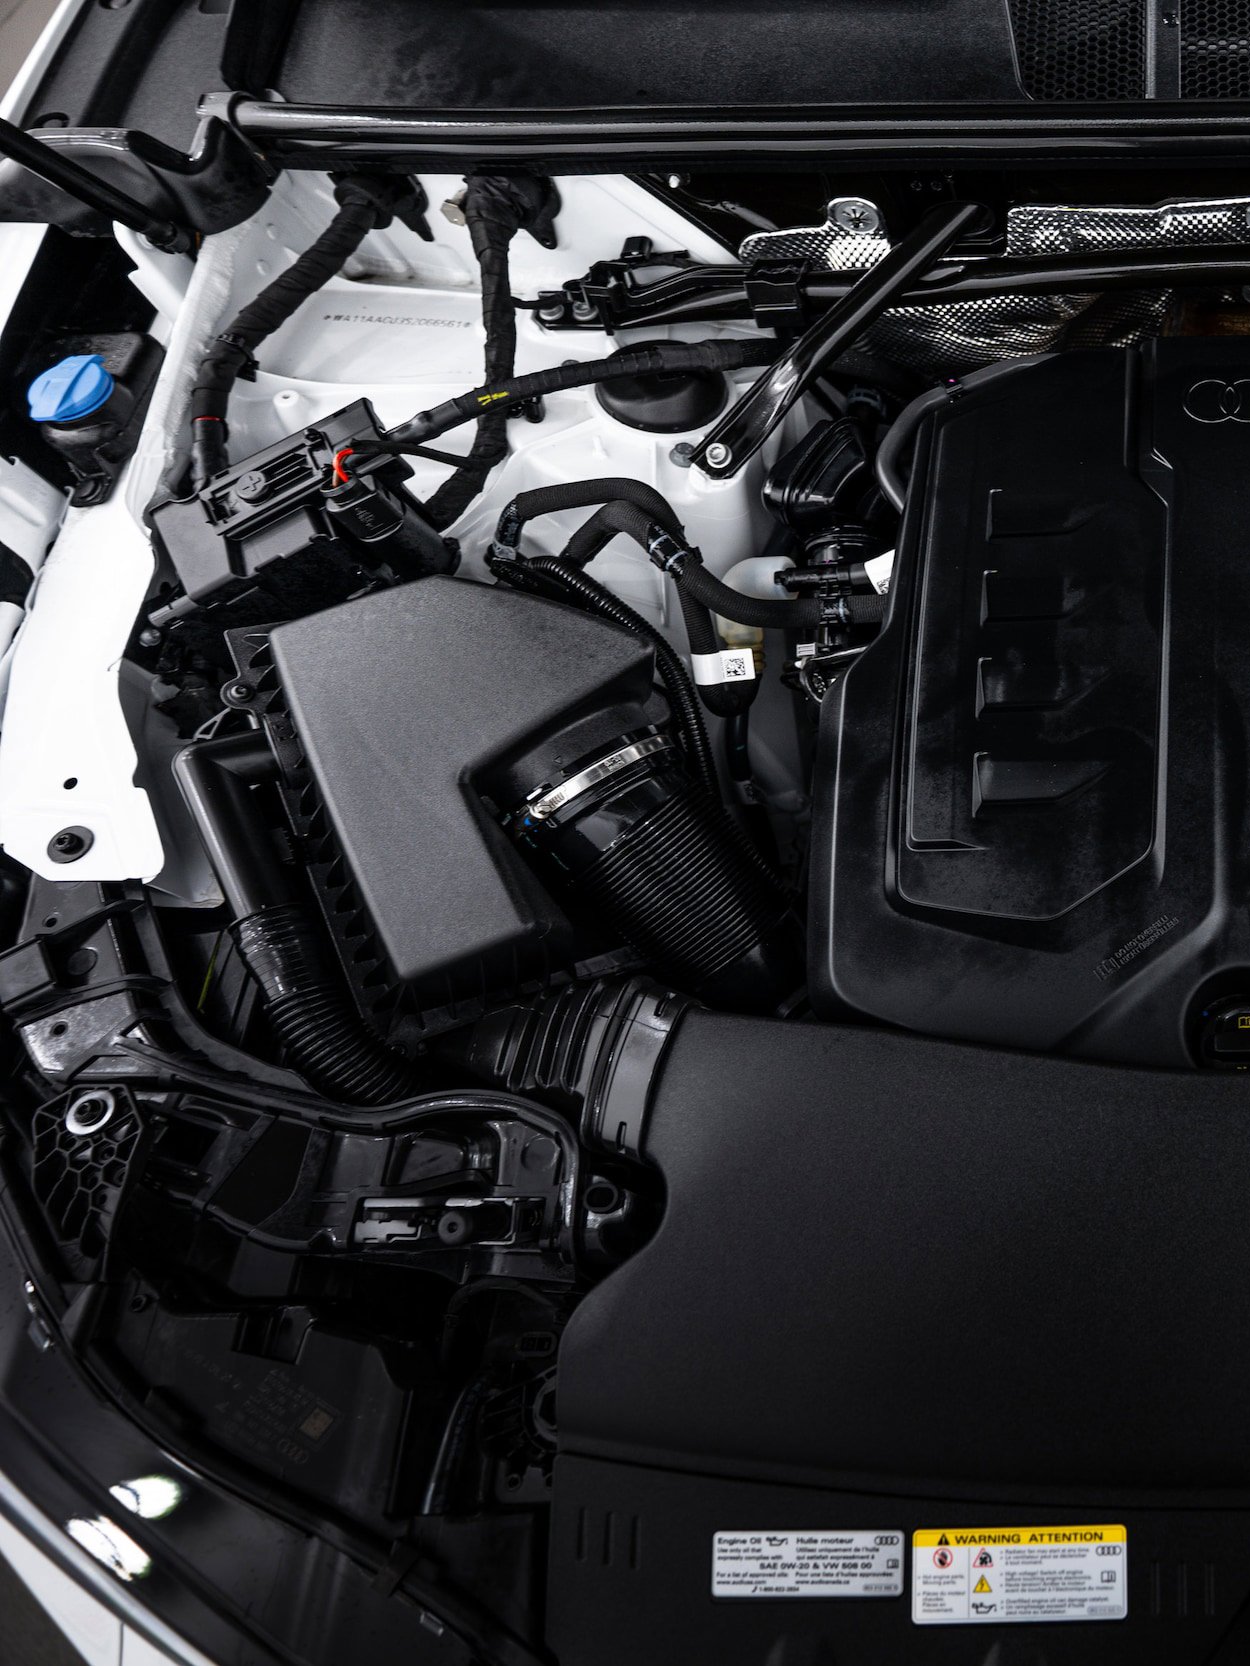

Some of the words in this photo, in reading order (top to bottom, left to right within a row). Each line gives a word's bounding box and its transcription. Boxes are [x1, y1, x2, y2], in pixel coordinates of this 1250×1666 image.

[717, 1537, 748, 1546] Engine
[954, 1533, 1021, 1544] WARNING
[1028, 1531, 1104, 1543] ATTENTION
[759, 1562, 778, 1570] SAE
[780, 1562, 810, 1570] 0W-20
[812, 1562, 820, 1570] &
[822, 1562, 840, 1570] VW
[841, 1562, 859, 1570] 508
[860, 1562, 872, 1570] 00
